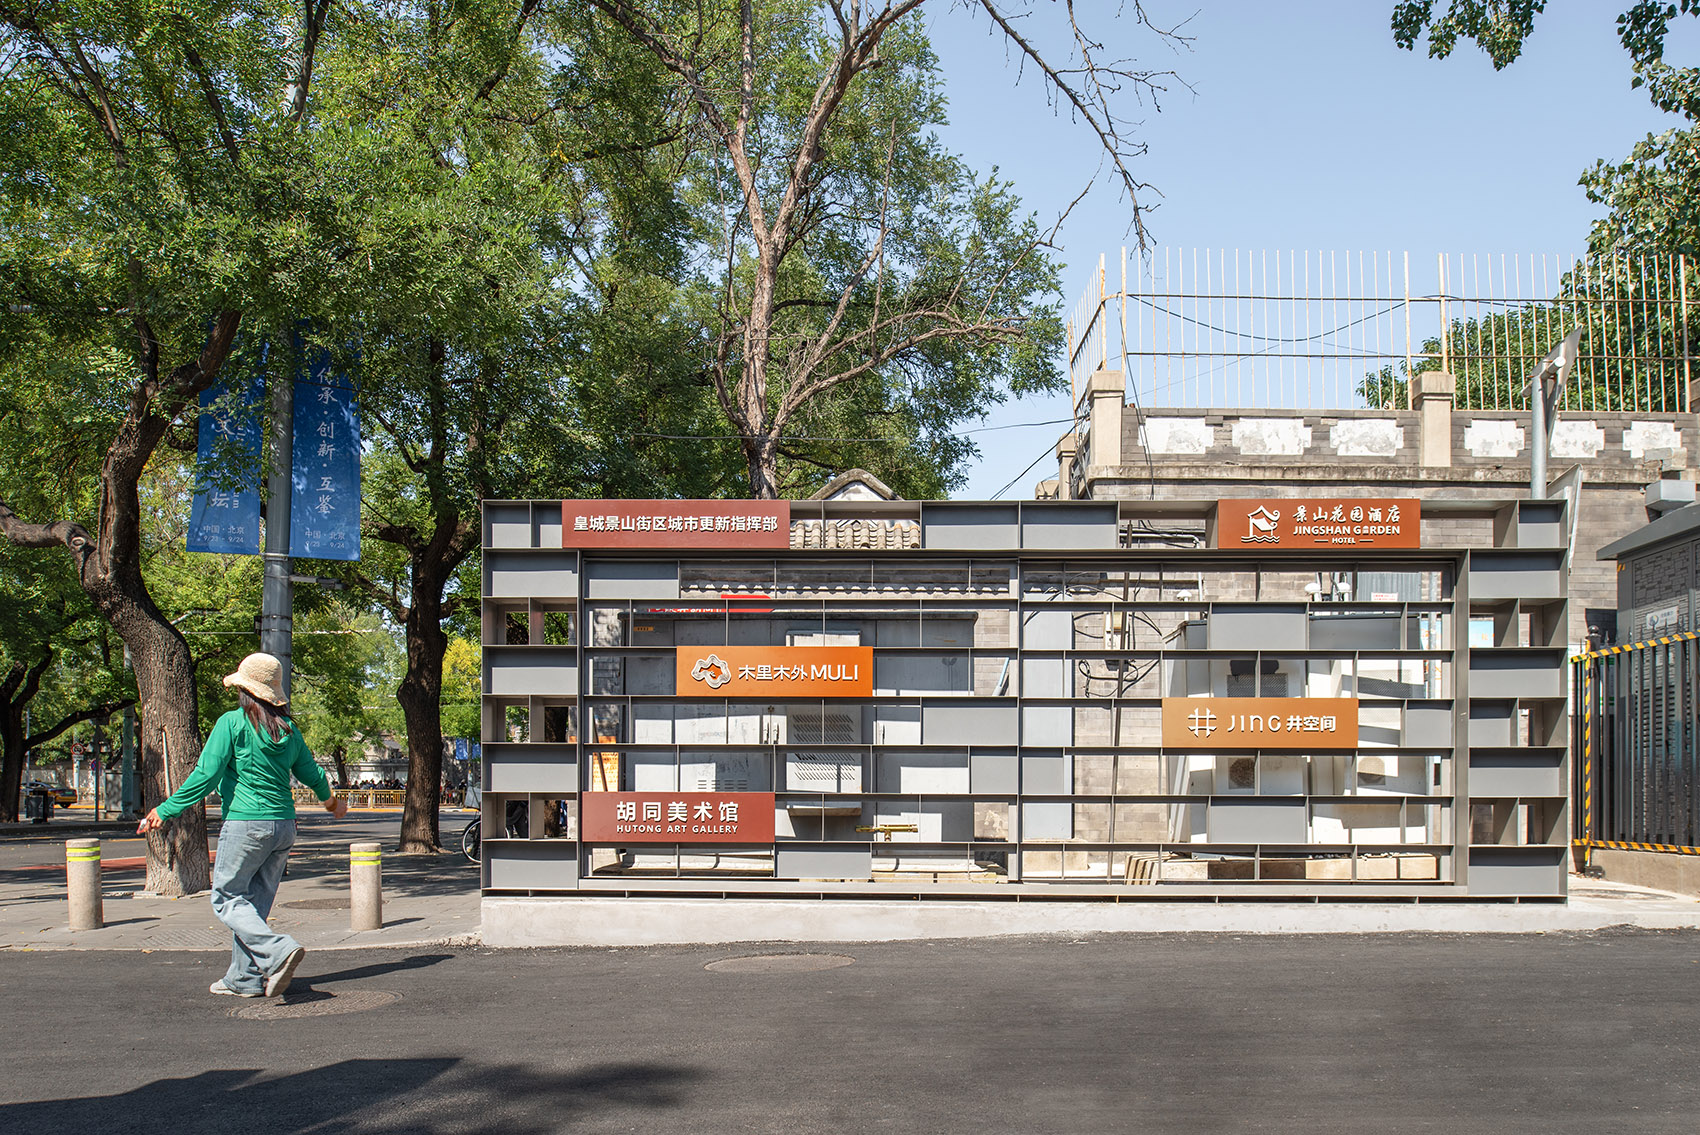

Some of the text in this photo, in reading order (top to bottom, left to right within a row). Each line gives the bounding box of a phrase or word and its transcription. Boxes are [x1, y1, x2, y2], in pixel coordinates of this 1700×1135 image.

[1292, 504, 1401, 523] 景山花园酒店
[573, 515, 778, 532] 皇城景山街区城市更新指挥部
[1293, 525, 1351, 536] JINGSHAN
[1286, 715, 1337, 733] 井空间
[616, 801, 739, 822] 胡同美术馆
[616, 824, 739, 834] HUTONG ART GALLERY
